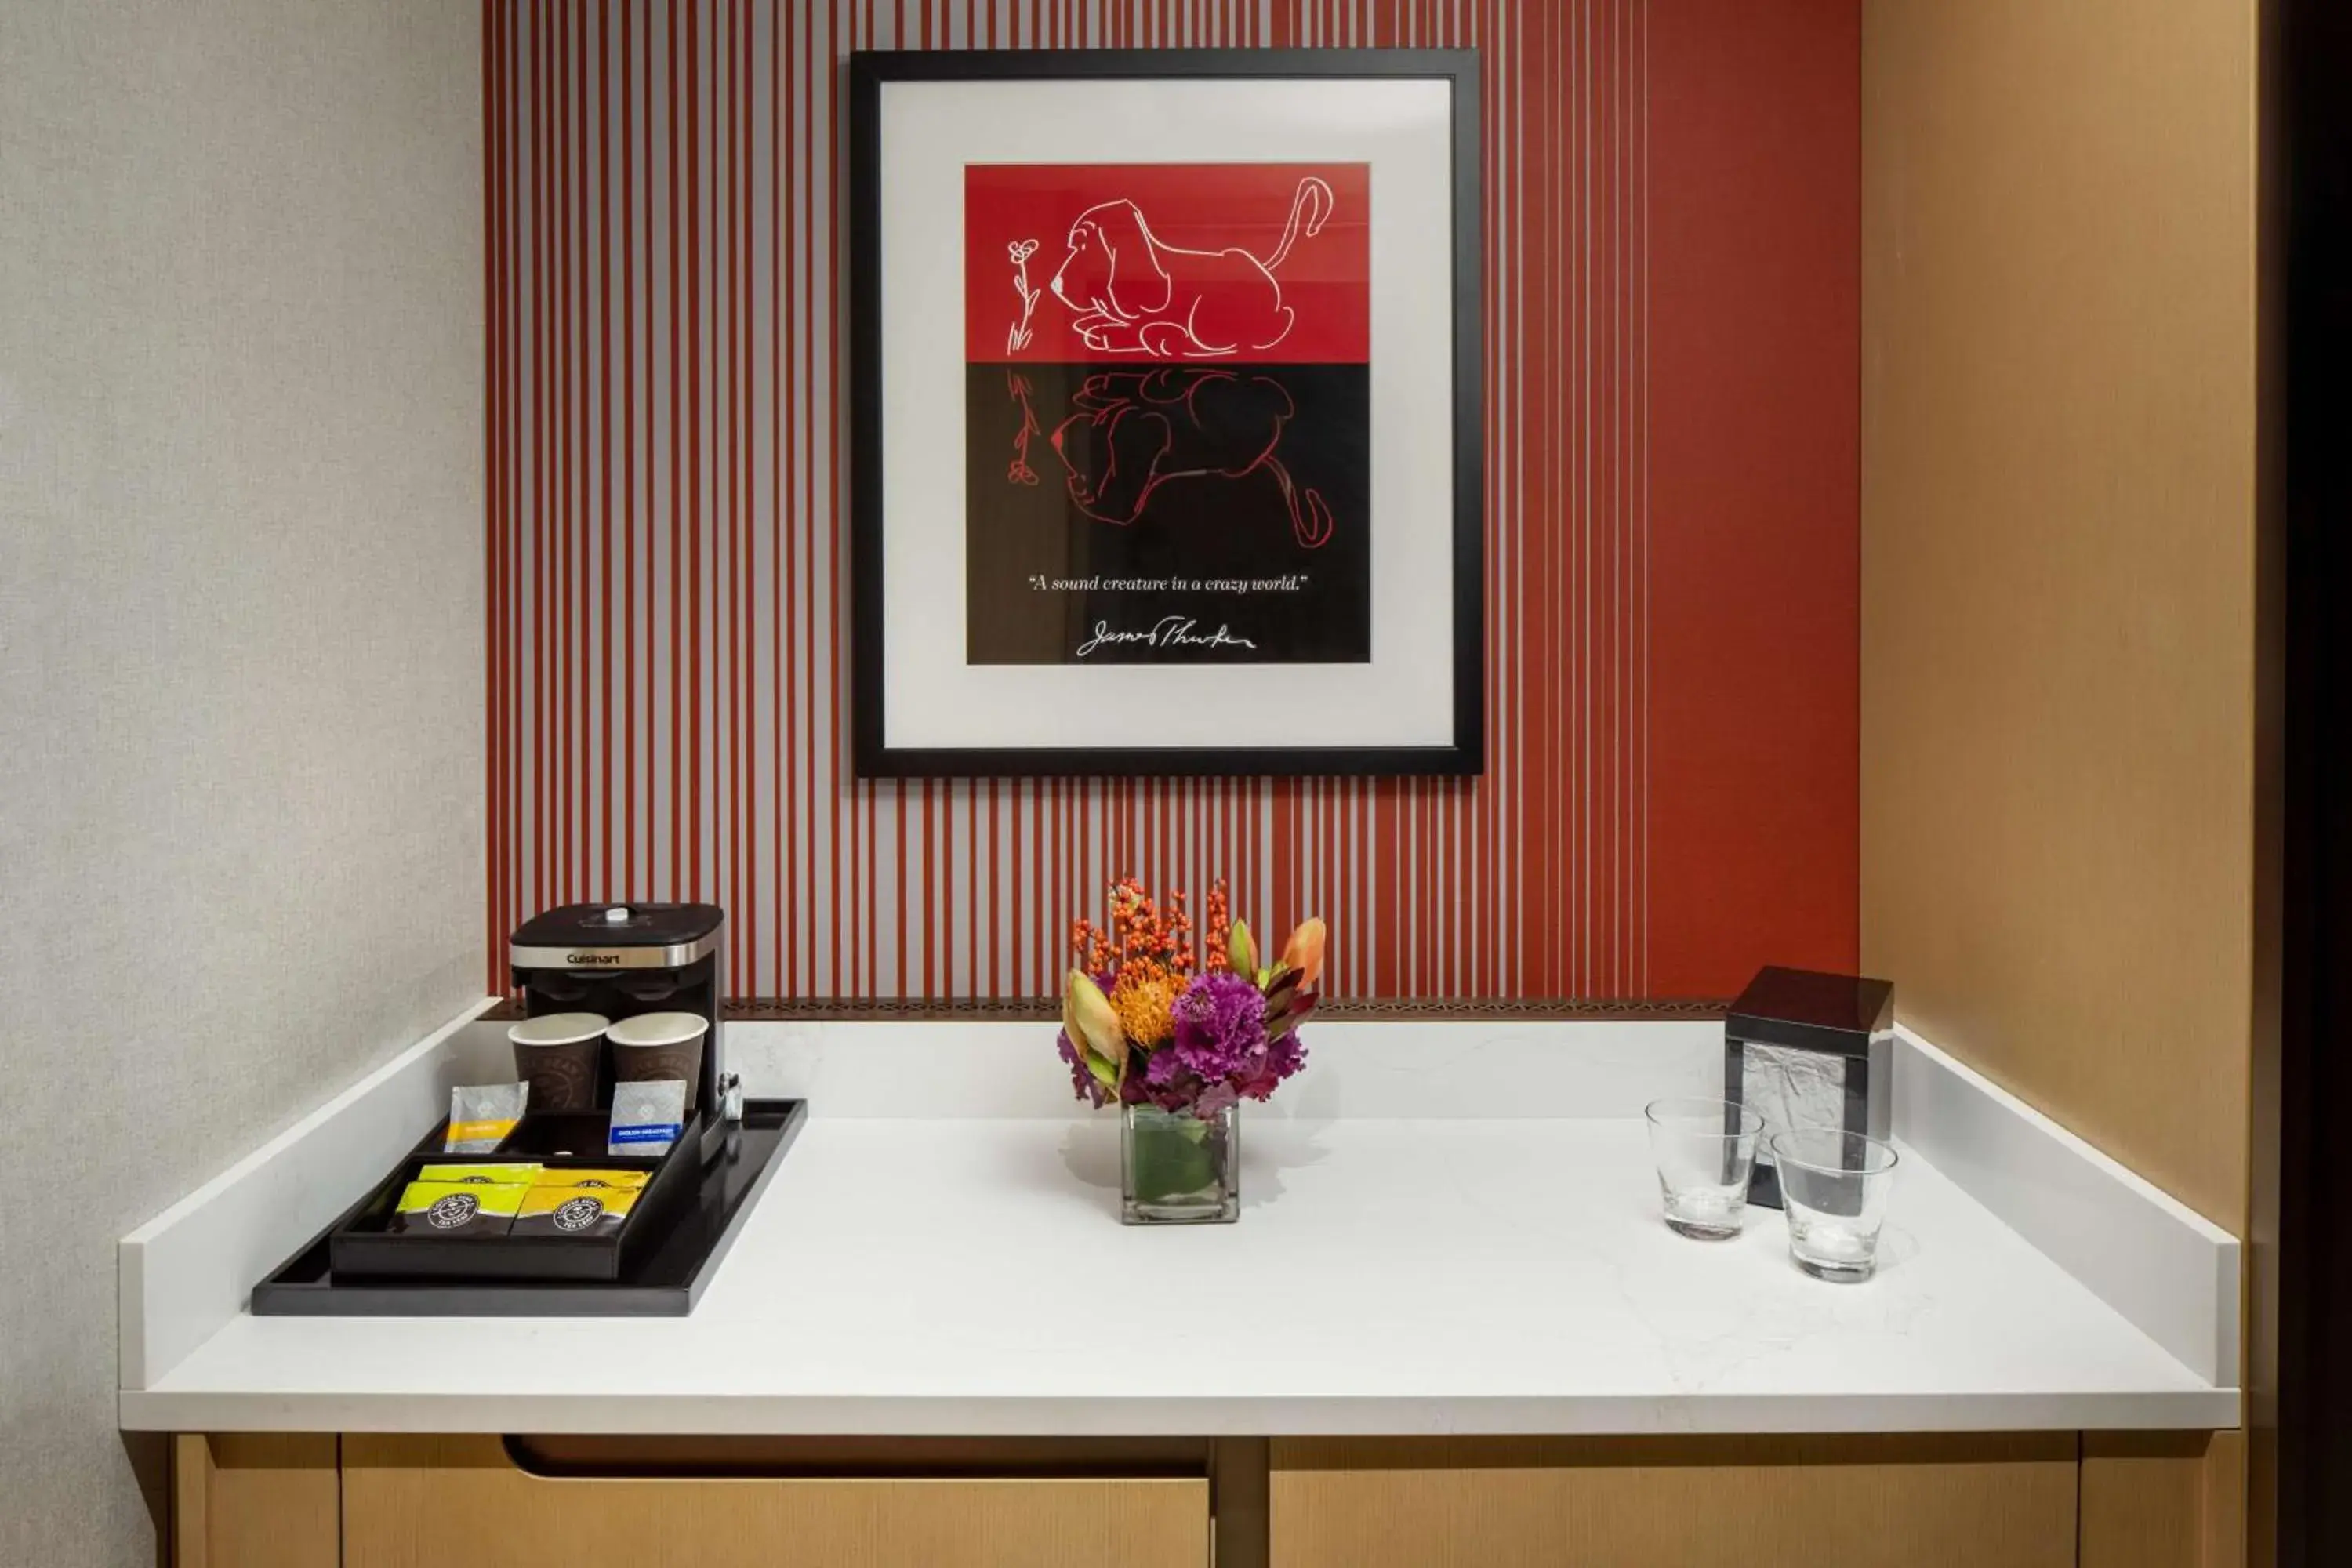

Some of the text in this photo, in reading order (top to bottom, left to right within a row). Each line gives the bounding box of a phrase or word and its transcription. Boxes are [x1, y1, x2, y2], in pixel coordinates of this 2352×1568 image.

[1051, 575, 1099, 591] sound
[1102, 578, 1167, 591] creature
[1171, 575, 1187, 591] in
[1191, 580, 1201, 591] a
[1205, 579, 1248, 594] crazy
[566, 953, 620, 964] Cuisinart
